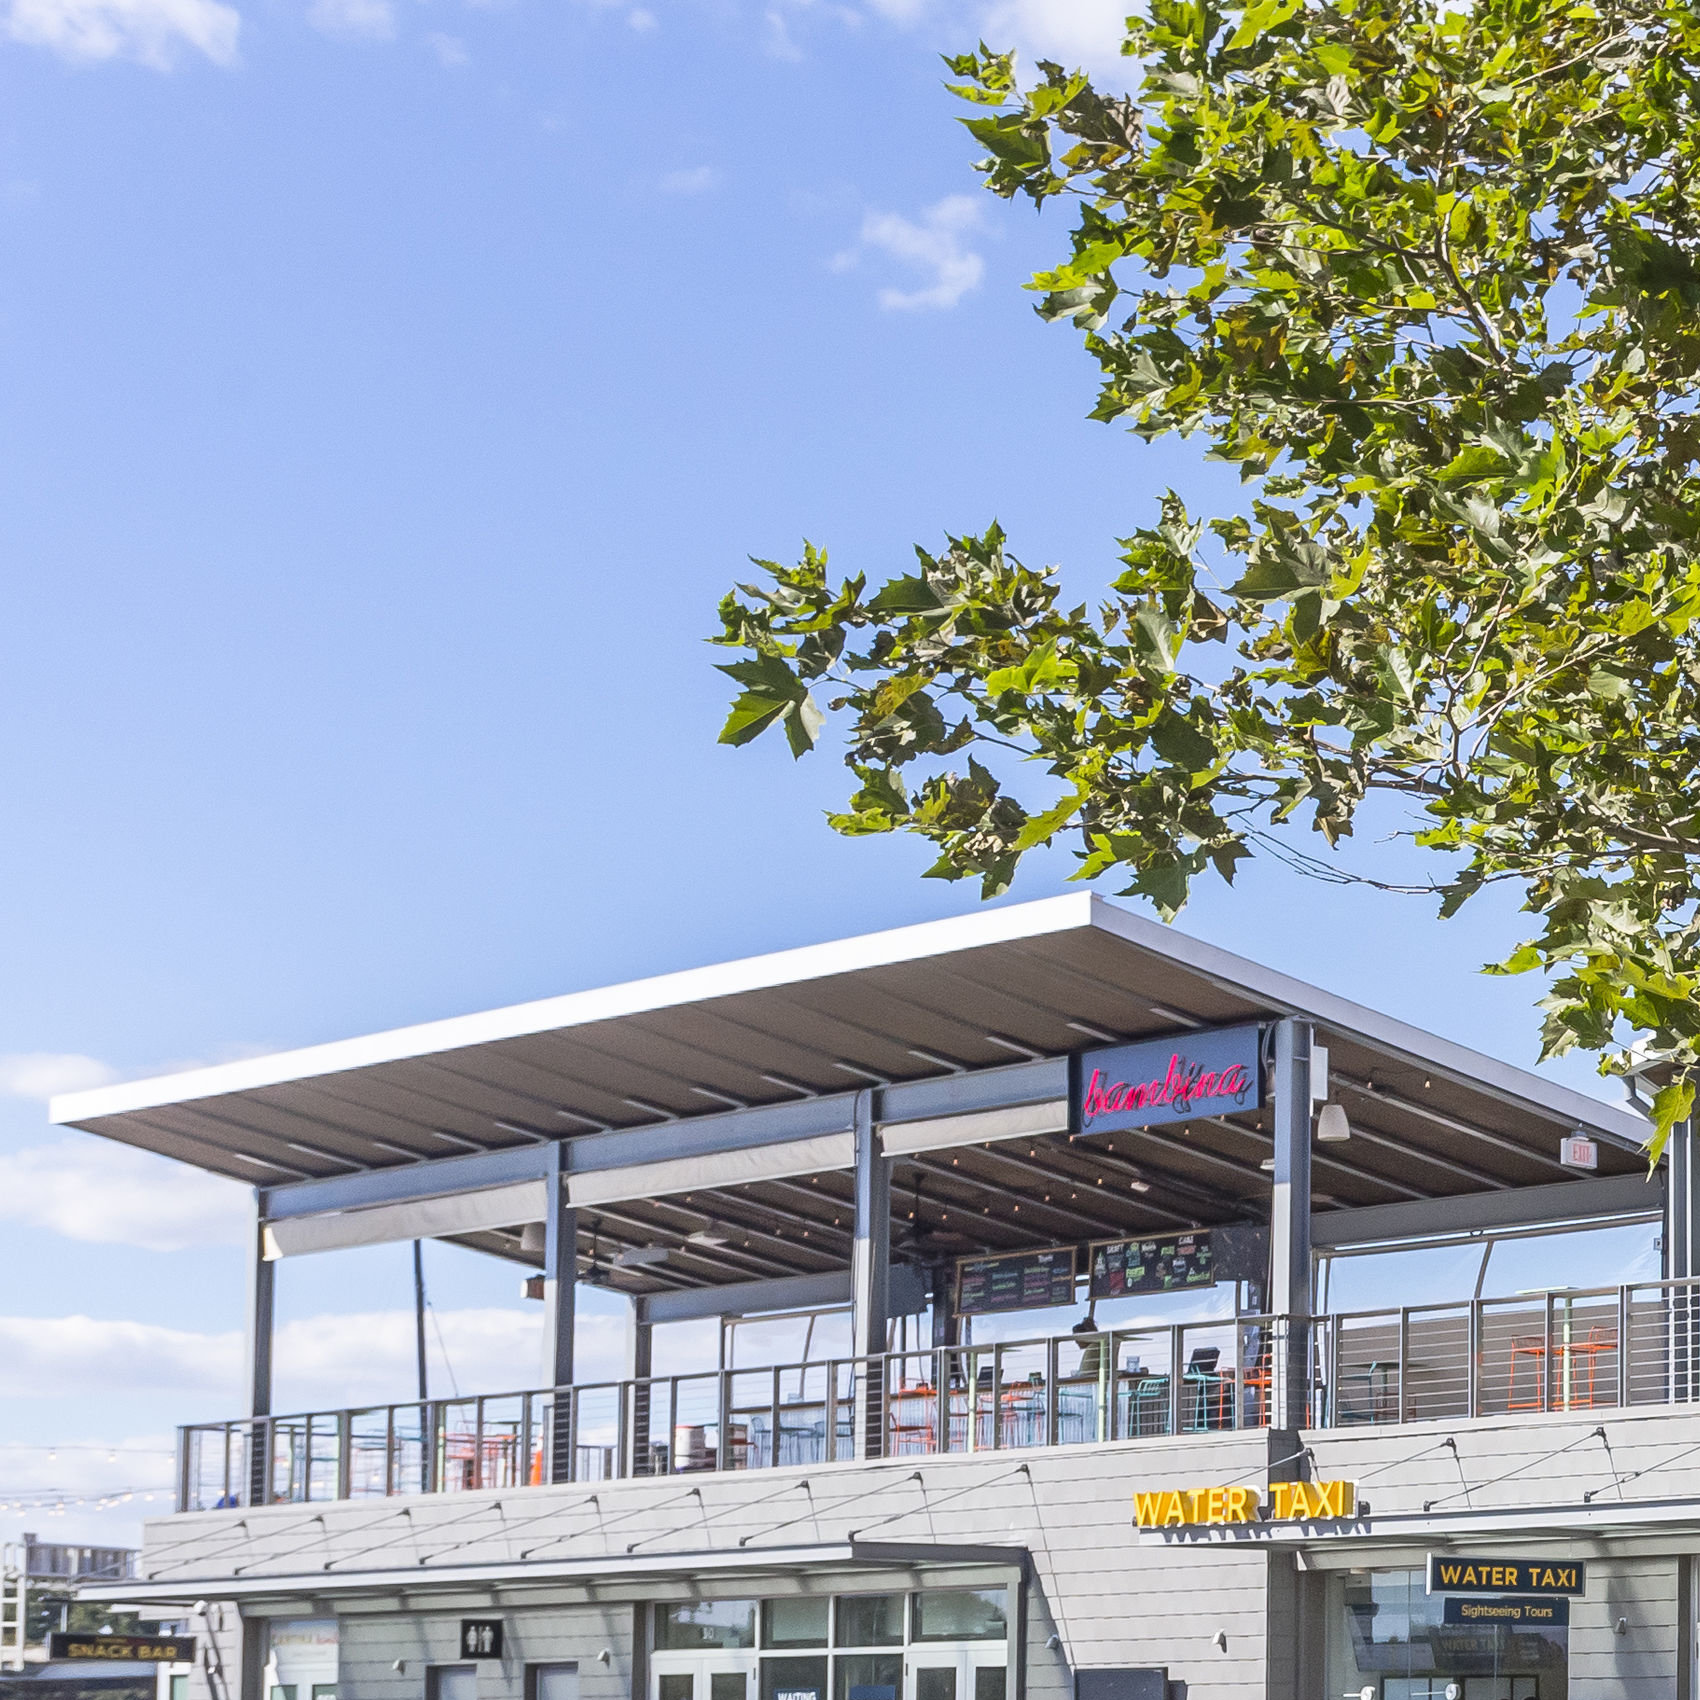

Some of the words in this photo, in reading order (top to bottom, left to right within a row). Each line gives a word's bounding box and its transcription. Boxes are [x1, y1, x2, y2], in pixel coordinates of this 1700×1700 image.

[1083, 1053, 1248, 1118] bambina
[1133, 1486, 1248, 1527] WATER
[1269, 1480, 1346, 1519] TAXI
[1440, 1565, 1518, 1586] WATER
[1528, 1567, 1576, 1588] TAXI
[1461, 1604, 1521, 1619] Sightseeing
[1524, 1605, 1553, 1618] Tours
[68, 1643, 133, 1658] SNACK
[138, 1644, 178, 1659] BAR
